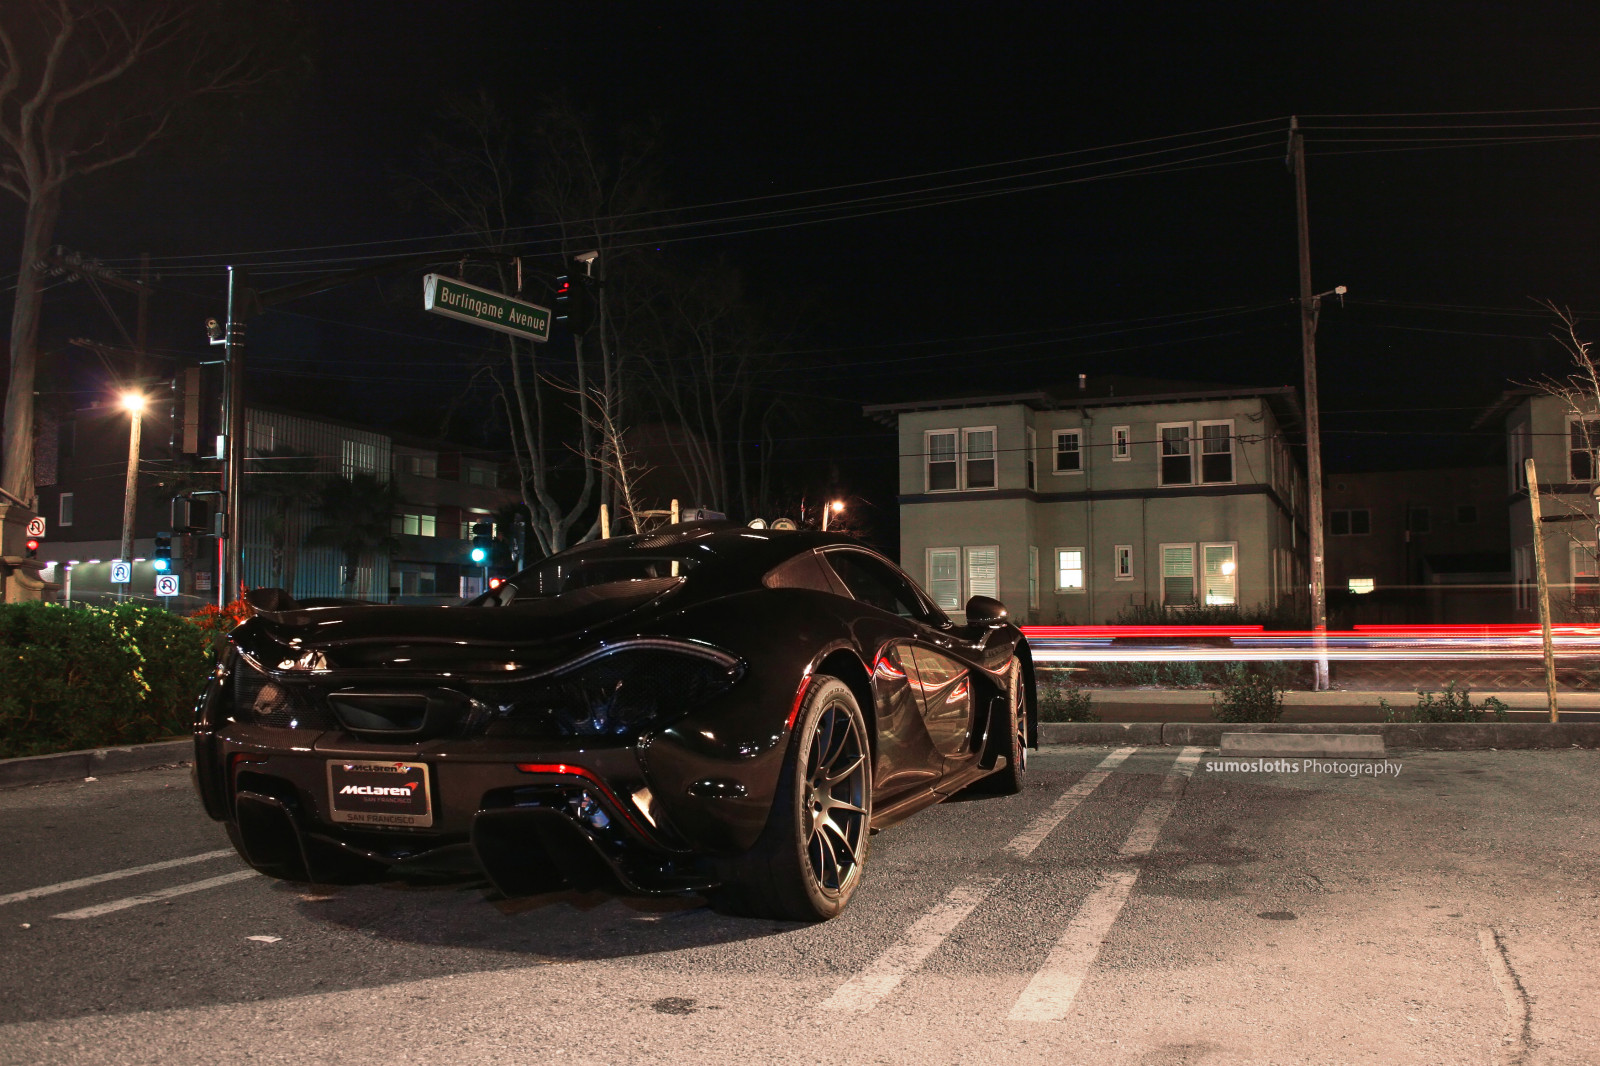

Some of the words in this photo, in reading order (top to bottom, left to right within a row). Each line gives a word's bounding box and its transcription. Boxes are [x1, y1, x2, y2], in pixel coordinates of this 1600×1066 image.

[440, 286, 504, 318] Burlingame
[508, 307, 545, 331] Avenue
[351, 764, 398, 772] McLaren
[339, 785, 411, 796] McLaren
[347, 813, 365, 821] SAN
[366, 814, 415, 825] FRANCISCO
